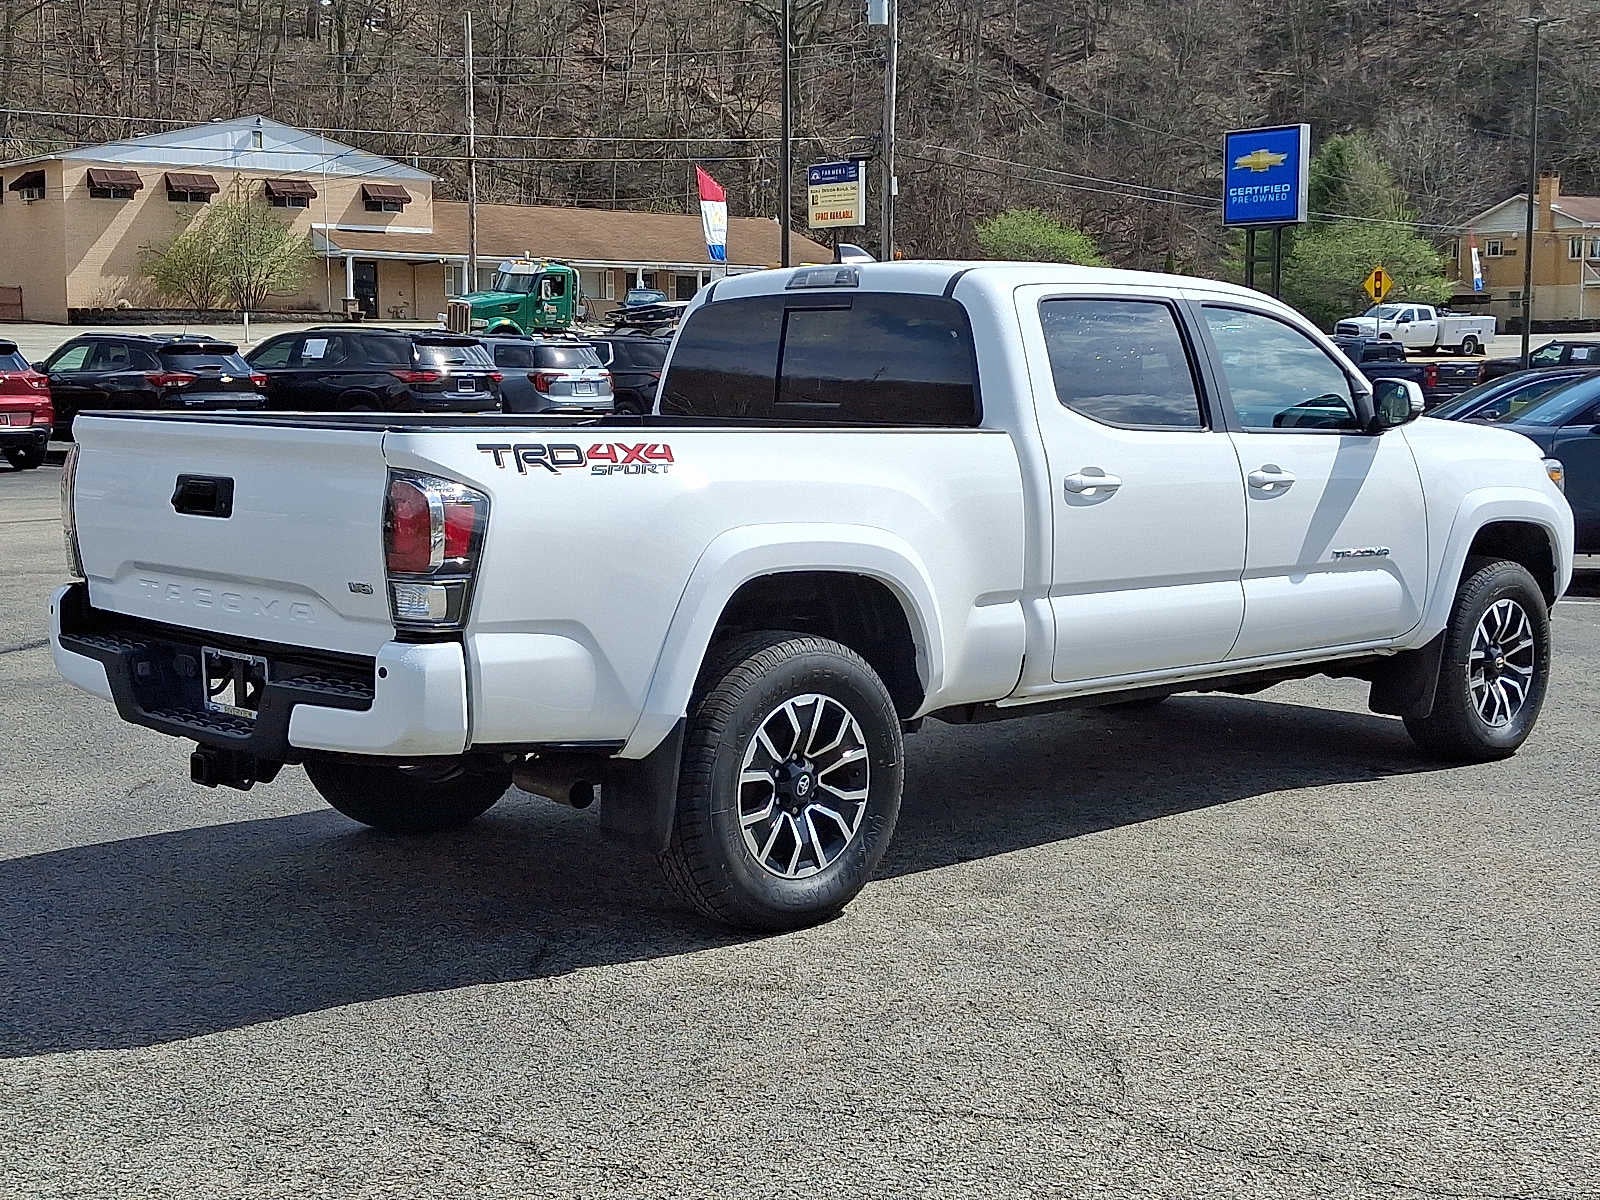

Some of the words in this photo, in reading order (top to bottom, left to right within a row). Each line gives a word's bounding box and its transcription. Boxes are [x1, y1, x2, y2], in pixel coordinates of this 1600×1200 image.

[1230, 184, 1290, 196] CERTIFIED
[1232, 193, 1287, 204] PRE-OWNED
[476, 443, 587, 475] TRD
[591, 463, 673, 476] SPORT
[138, 578, 319, 624] TACOMA
